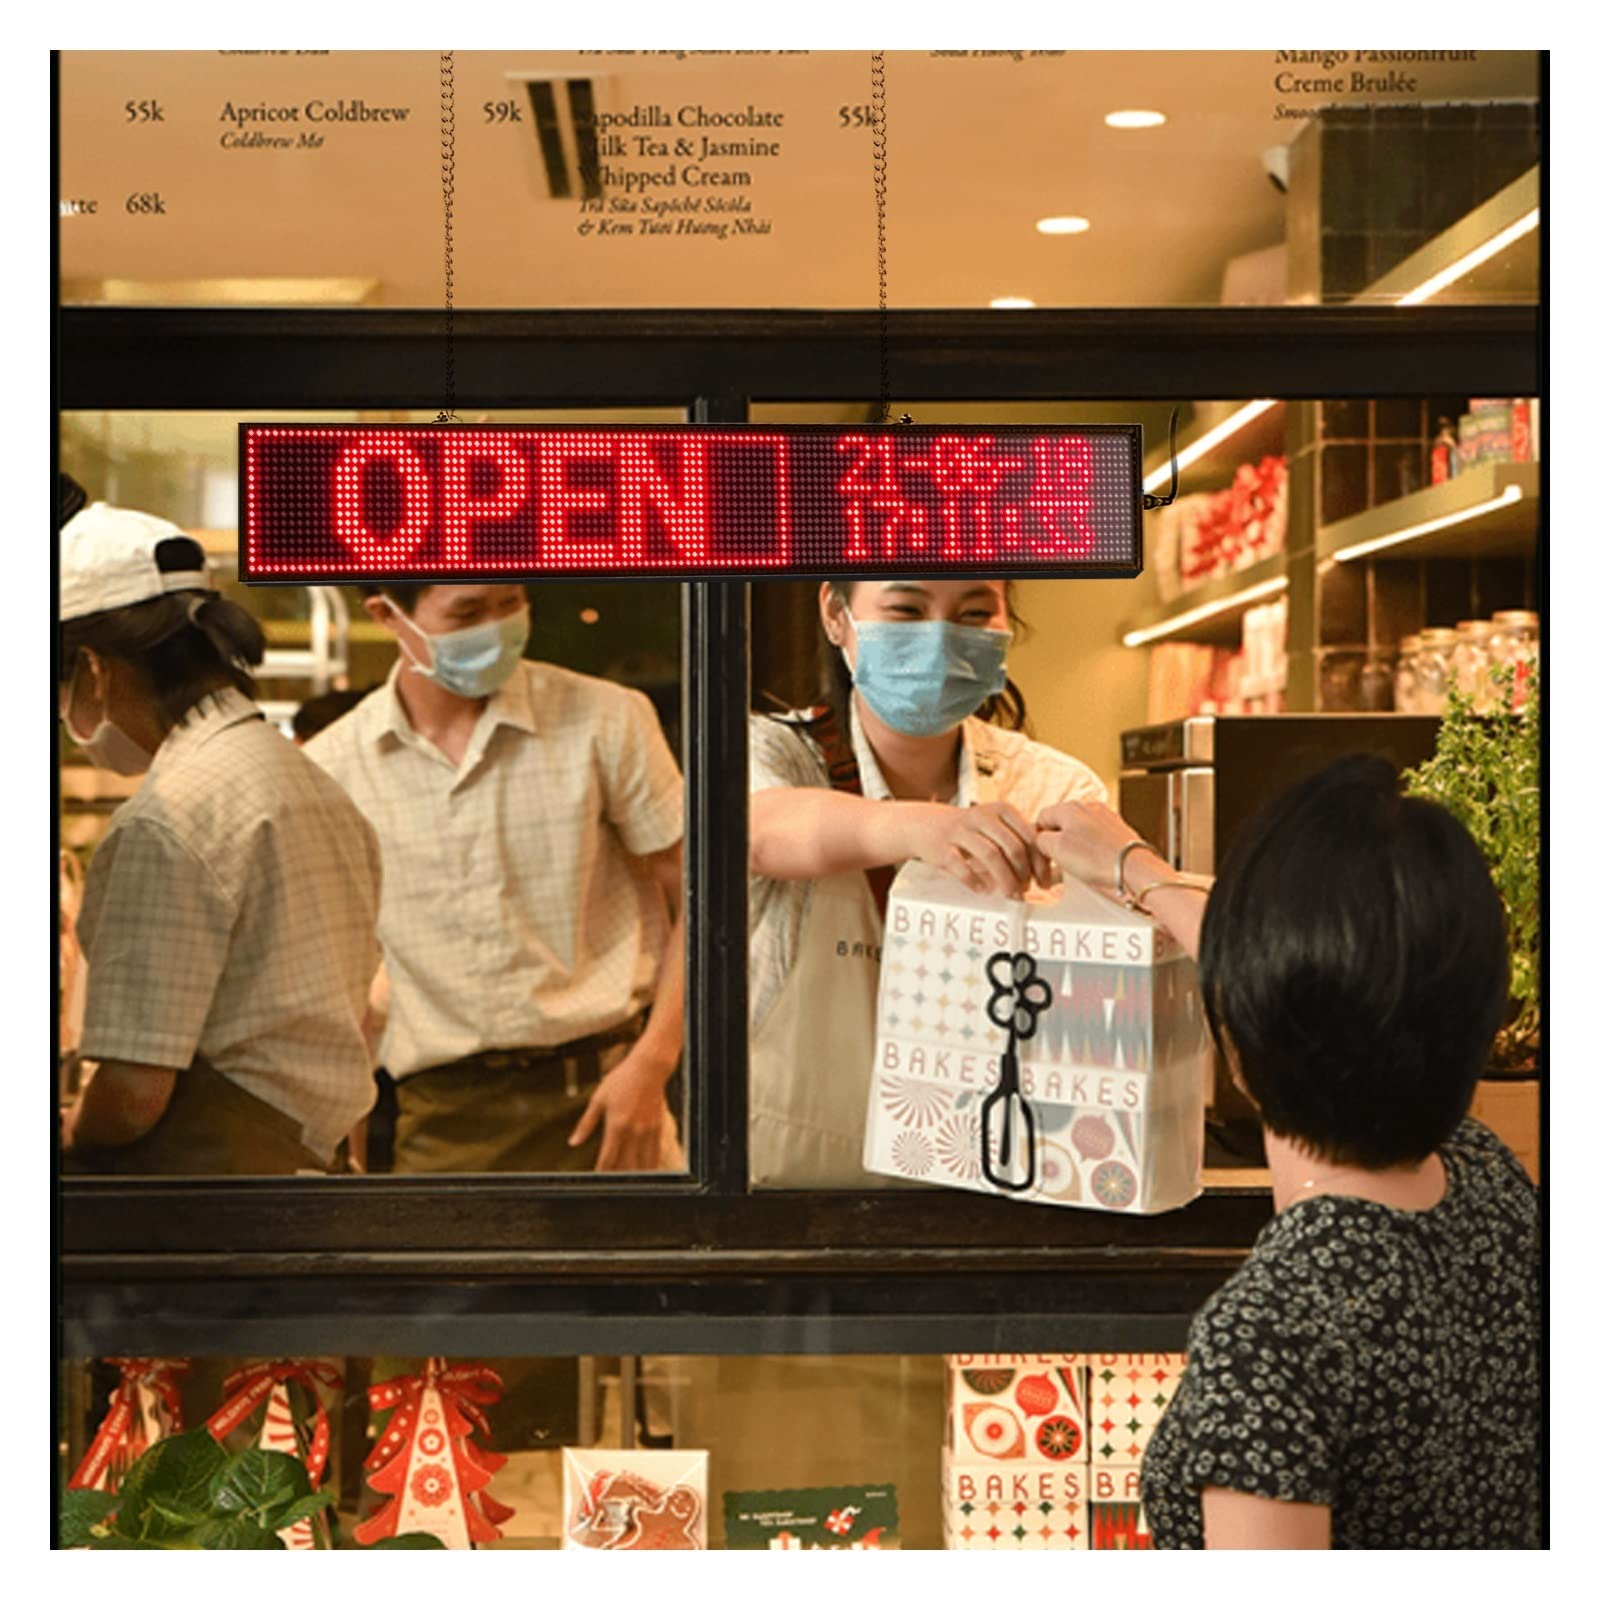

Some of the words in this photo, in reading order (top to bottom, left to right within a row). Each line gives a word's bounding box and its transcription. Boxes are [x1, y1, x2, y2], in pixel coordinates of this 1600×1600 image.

[1275, 72, 1345, 93] Creme
[1351, 71, 1417, 93] Brulée
[125, 100, 165, 123] 55k
[220, 101, 300, 128] Apricot
[305, 100, 411, 123] Coldbrew
[482, 100, 523, 125] 59k
[677, 105, 785, 128] Chocolate
[220, 131, 293, 149] Coldbrew
[632, 136, 669, 158] Tea
[674, 137, 694, 158] &
[697, 136, 781, 163] Jasmine
[681, 165, 752, 188] Cream
[125, 192, 166, 217] 68k
[577, 219, 597, 237] &
[598, 219, 634, 237] Kem
[333, 438, 708, 565] OPEN
[893, 905, 1009, 947] BAKES
[1026, 926, 1143, 961] BAKES
[882, 1042, 1000, 1087] BAKES
[1022, 1068, 1139, 1108] BAKES
[958, 1472, 1081, 1500] BAKES
